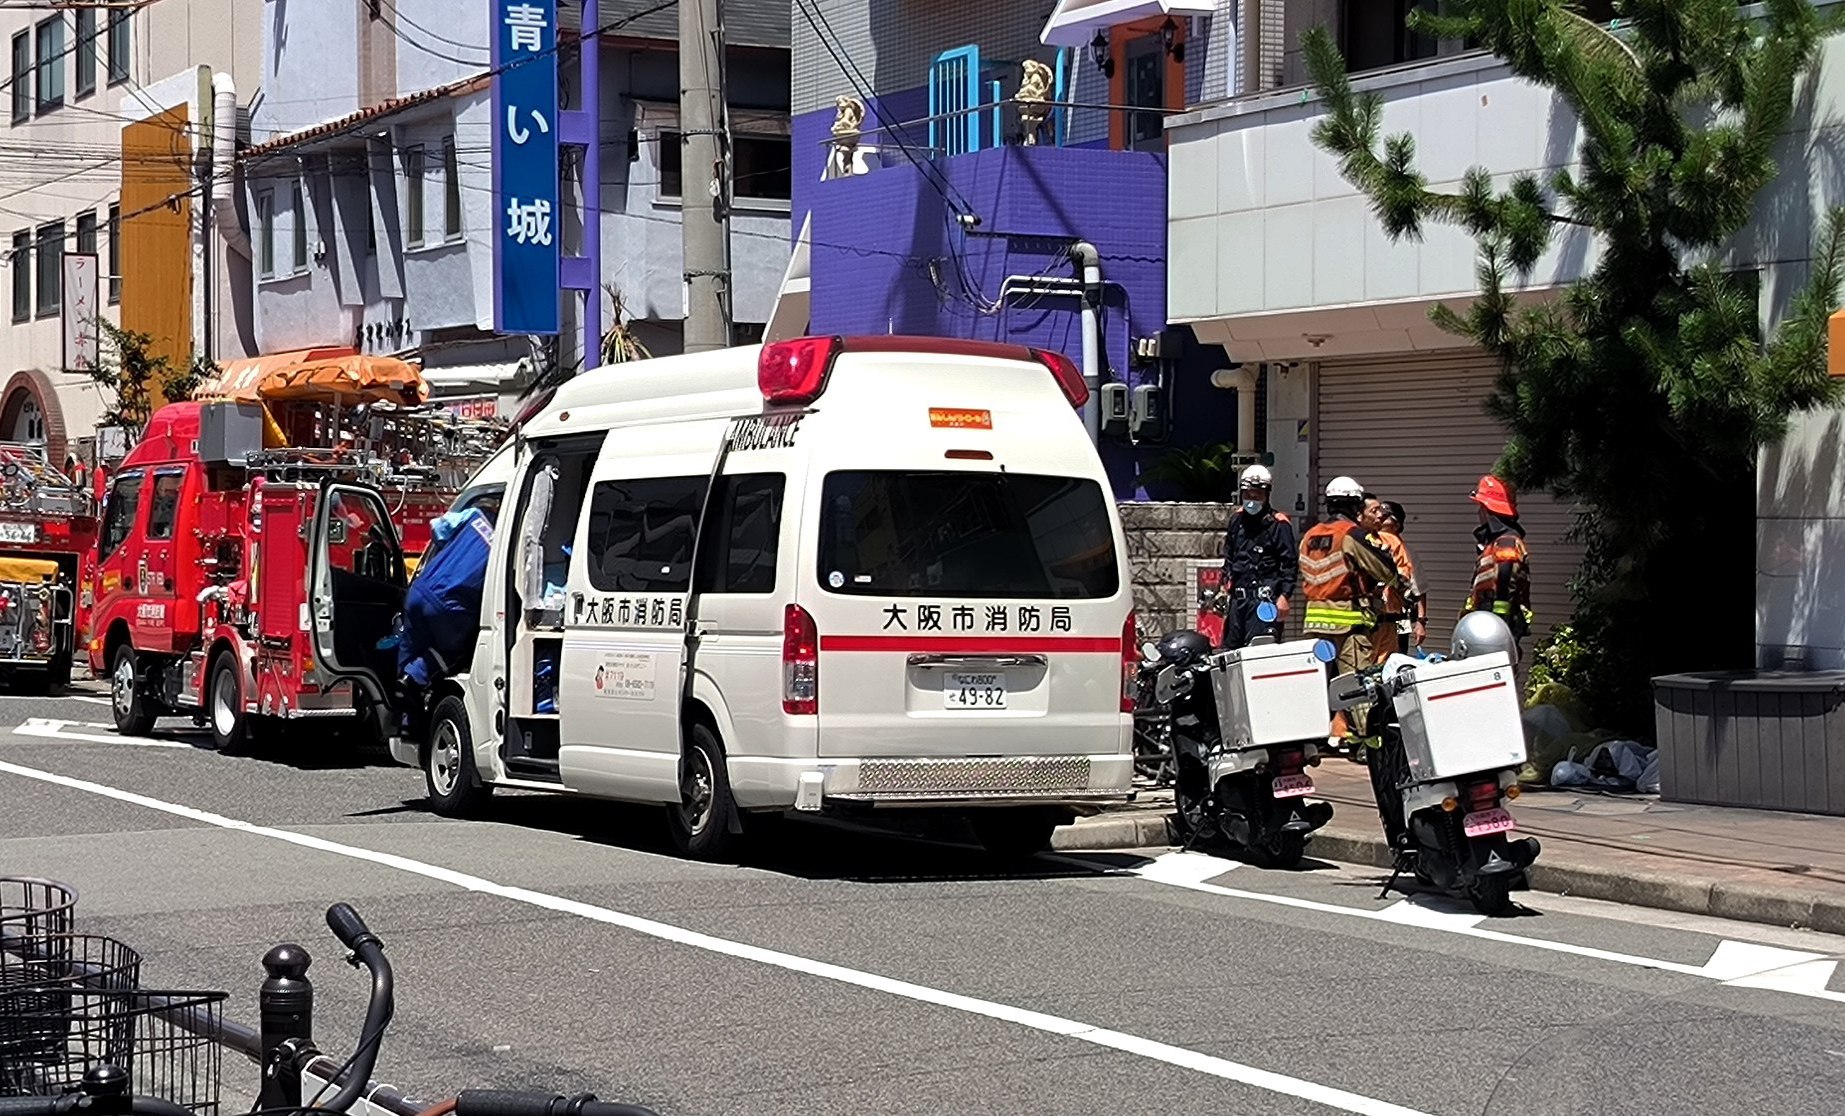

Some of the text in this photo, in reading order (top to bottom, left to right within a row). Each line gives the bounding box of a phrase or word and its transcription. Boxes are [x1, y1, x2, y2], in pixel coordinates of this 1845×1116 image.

[504, 3, 552, 247] 青い城
[586, 597, 682, 626] 大阪市消防局
[883, 603, 1072, 632] 大阪市消防局
[1494, 672, 1501, 681] 8
[959, 687, 1003, 705] 49-82
